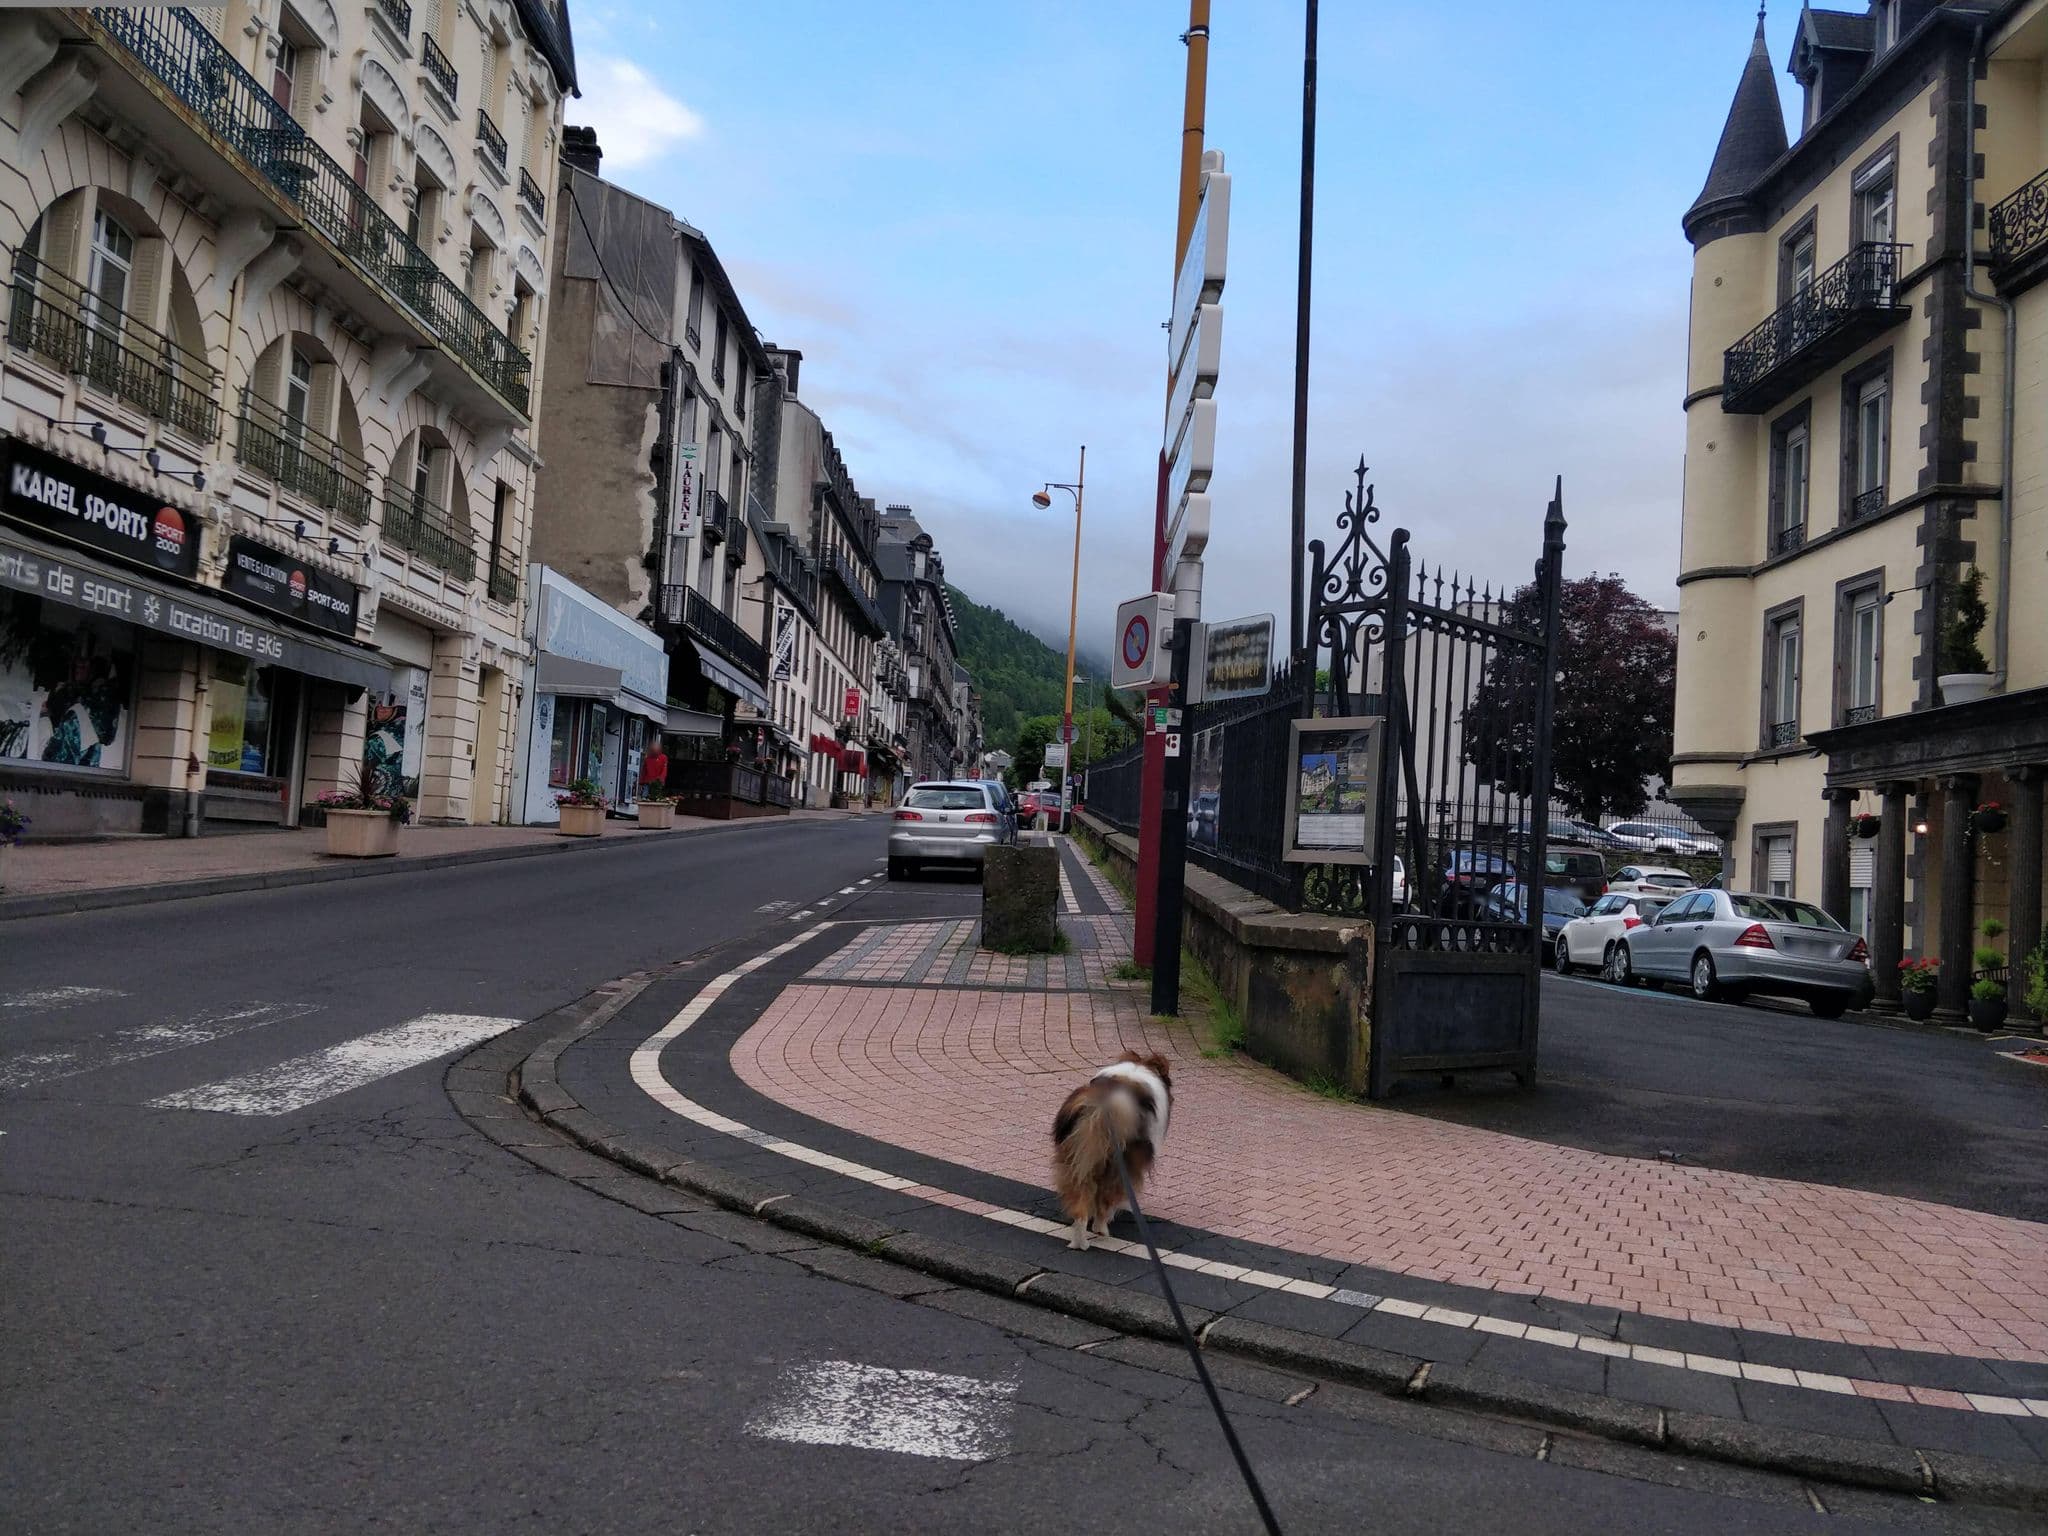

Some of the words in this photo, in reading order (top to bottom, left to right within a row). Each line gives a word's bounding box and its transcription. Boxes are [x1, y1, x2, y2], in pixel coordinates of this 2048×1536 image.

[12, 464, 79, 516] KAREL
[83, 494, 148, 541] SPORTS
[681, 461, 693, 521] LAURENT
[154, 522, 185, 542] SPORT
[156, 537, 181, 555] 2000
[289, 580, 305, 592] SPORT
[47, 566, 74, 596] de
[82, 581, 132, 613] sport
[169, 604, 230, 643] location
[235, 627, 253, 650] de
[256, 634, 282, 659] skis
[307, 589, 331, 607] SPORT
[331, 598, 350, 615] 2000
